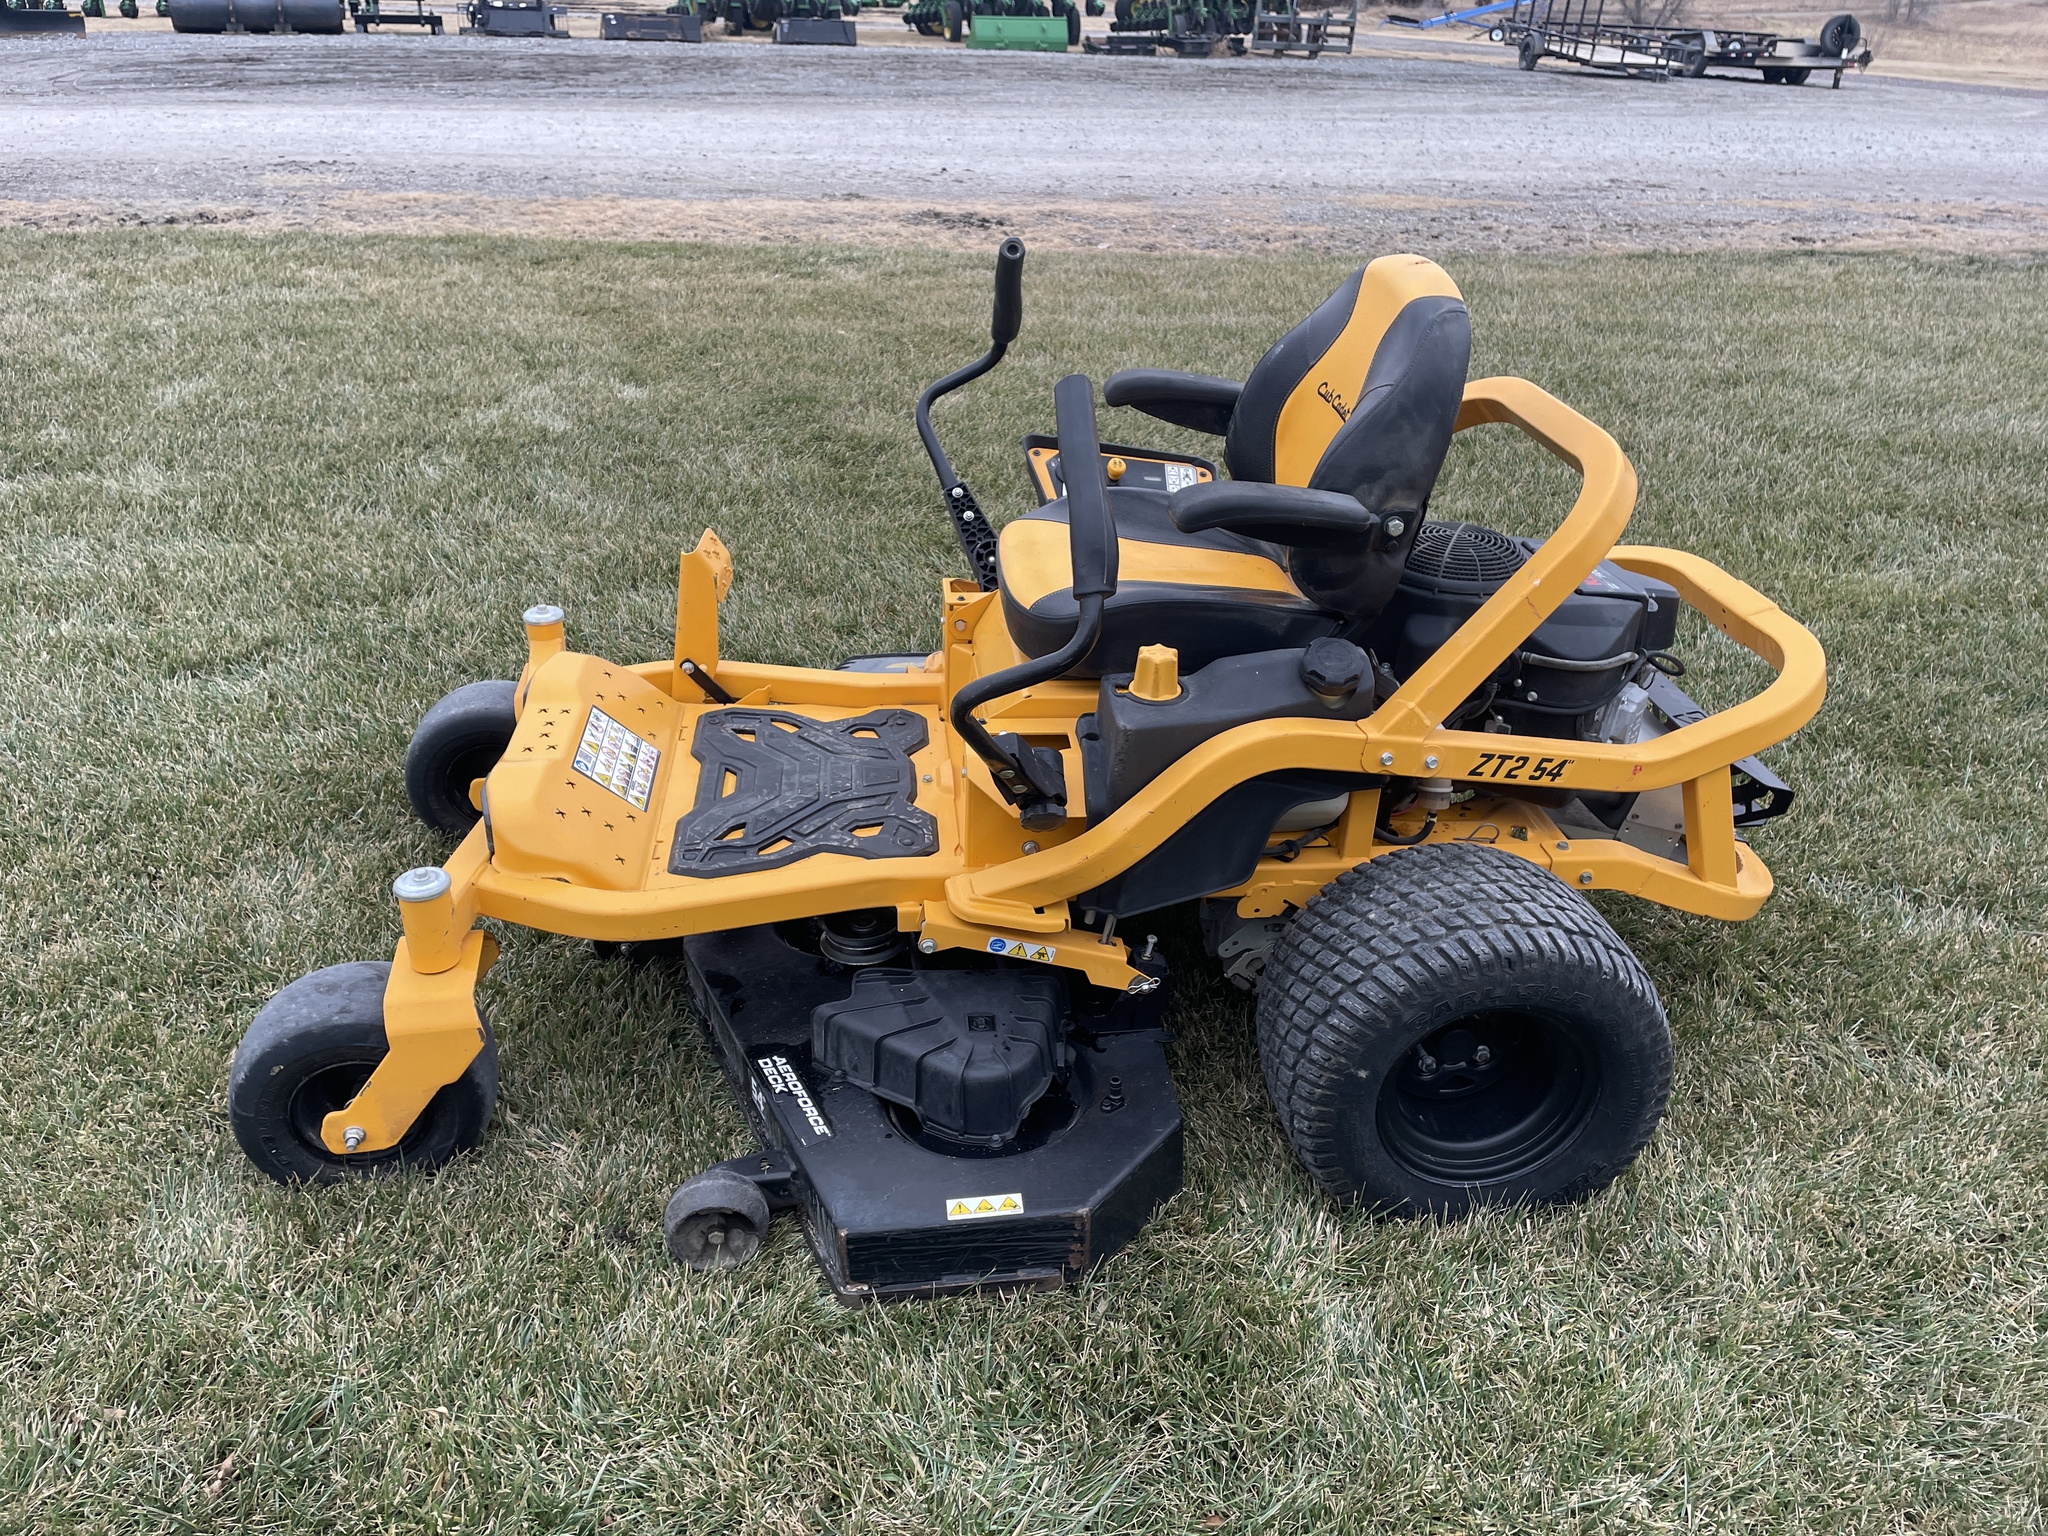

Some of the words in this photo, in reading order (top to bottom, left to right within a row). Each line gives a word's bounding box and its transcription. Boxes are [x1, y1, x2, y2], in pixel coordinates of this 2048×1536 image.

[1317, 381, 1335, 404] Cub
[1331, 394, 1351, 423] Cadet
[1467, 752, 1530, 780] ZT2
[1528, 757, 1576, 782] 54"
[1405, 983, 1593, 1036] CARLISLE
[757, 1058, 789, 1094] DECK
[772, 1055, 827, 1136] AEROFORCE
